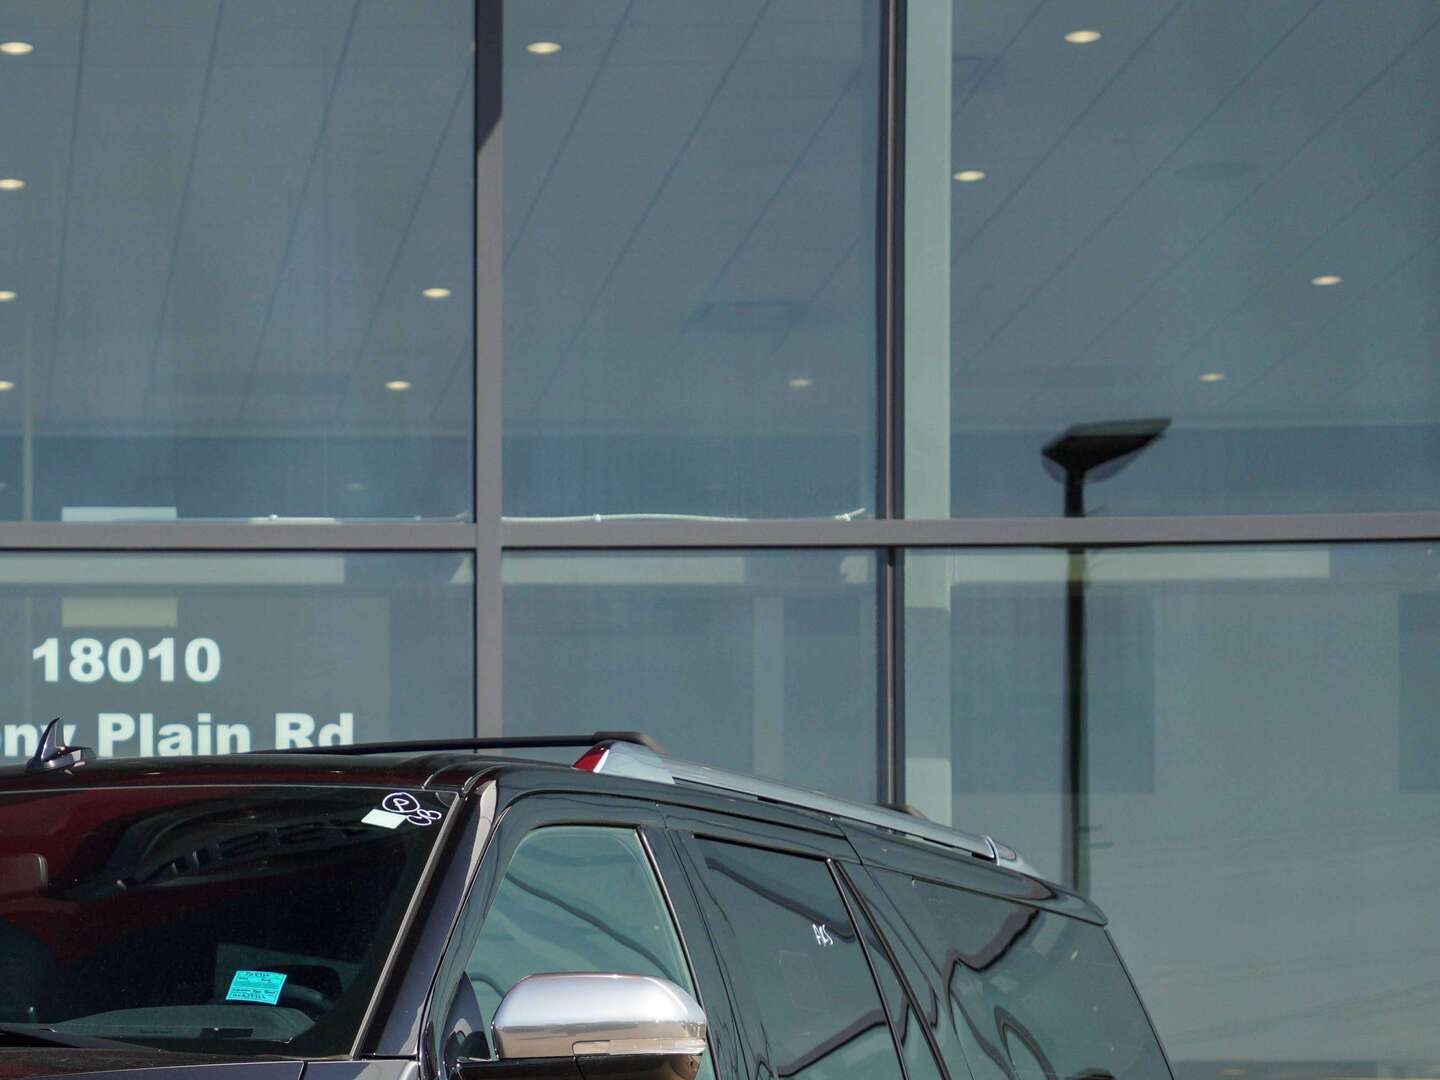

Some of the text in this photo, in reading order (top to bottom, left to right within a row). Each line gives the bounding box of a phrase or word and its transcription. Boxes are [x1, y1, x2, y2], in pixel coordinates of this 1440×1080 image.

[32, 637, 221, 683] 18010
[98, 713, 251, 757] Plain
[275, 713, 354, 750] Rd
